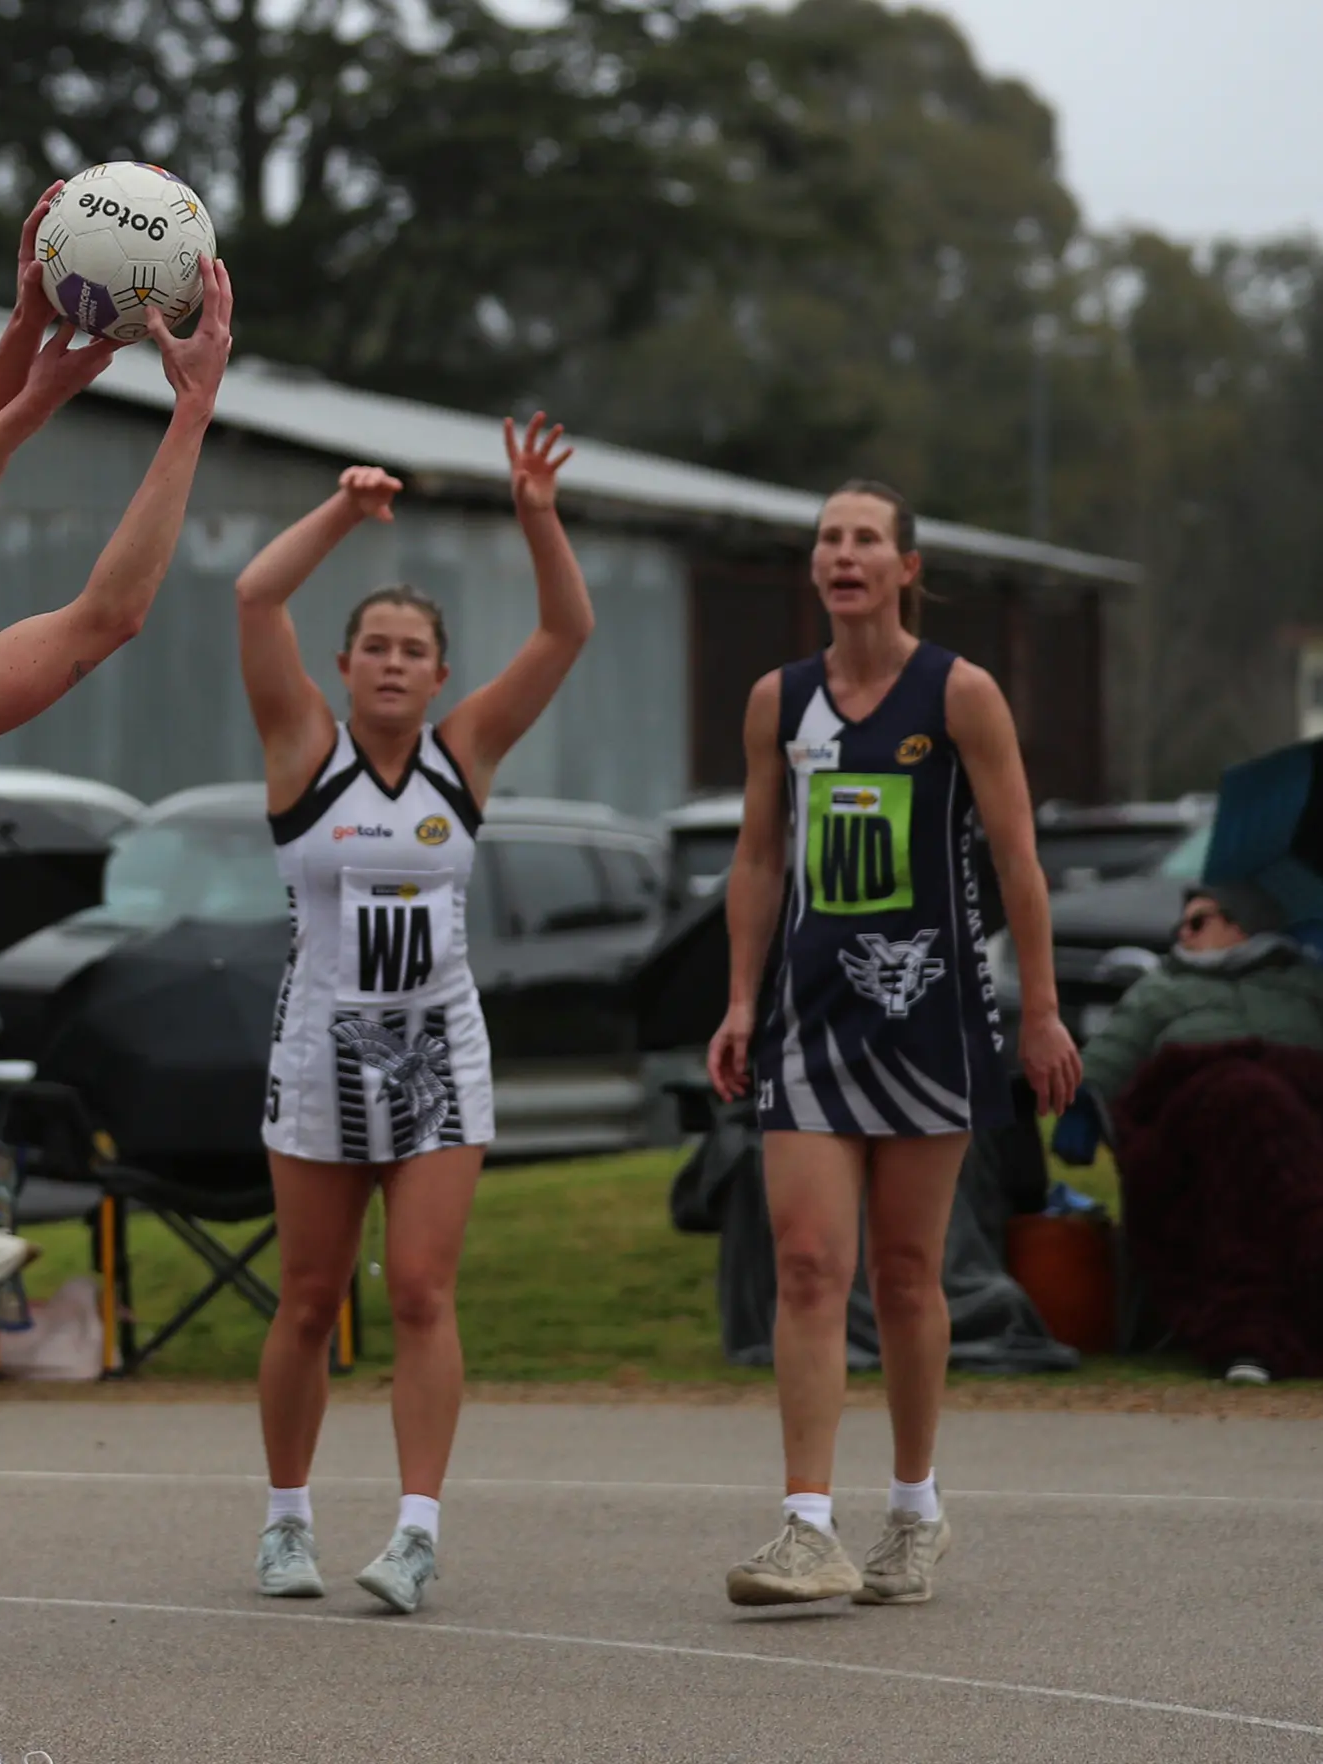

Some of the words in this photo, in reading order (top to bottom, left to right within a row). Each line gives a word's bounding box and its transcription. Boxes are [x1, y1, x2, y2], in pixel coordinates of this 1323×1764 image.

[79, 193, 169, 241] gotafe
[333, 823, 394, 843] gotafe
[821, 813, 896, 904] WD
[357, 905, 434, 993] WA
